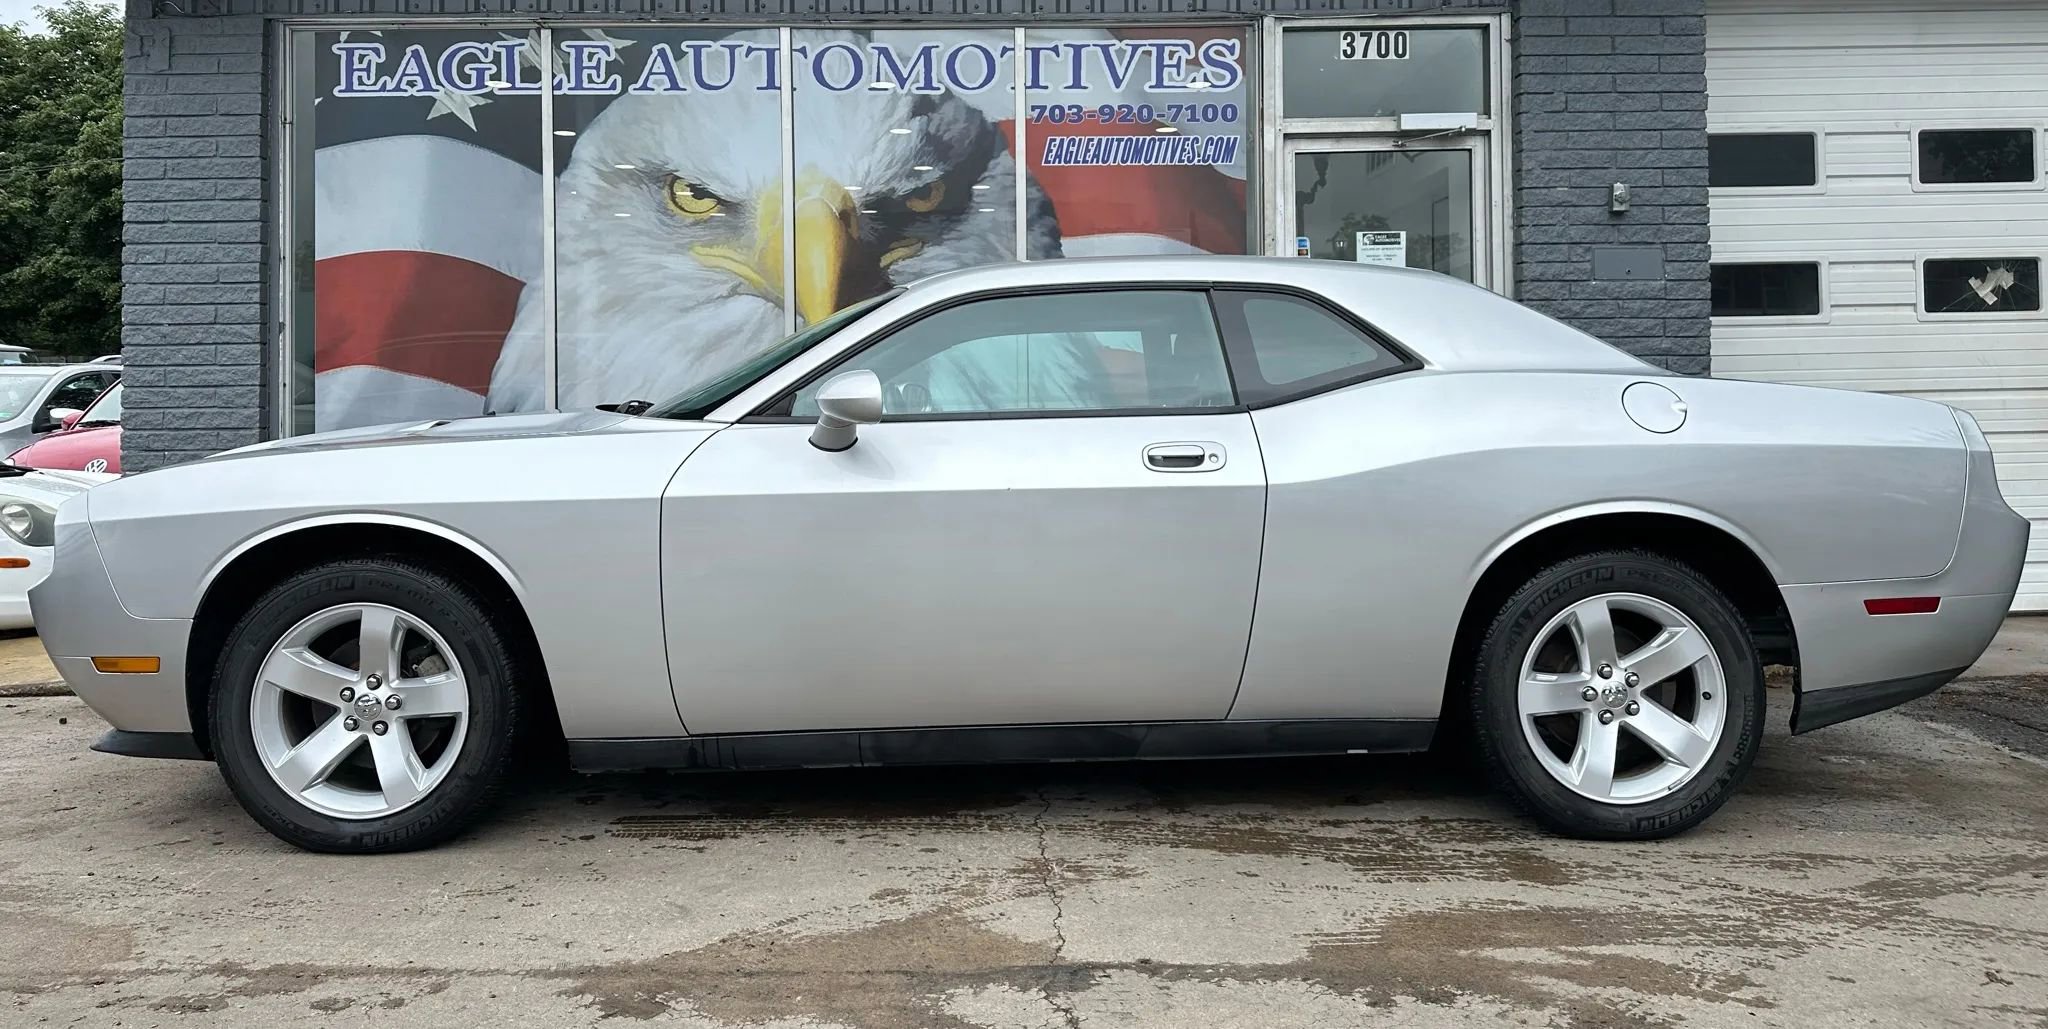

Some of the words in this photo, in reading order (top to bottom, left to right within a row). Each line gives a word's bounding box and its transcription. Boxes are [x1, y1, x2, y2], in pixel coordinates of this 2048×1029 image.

[1342, 31, 1408, 59] 3700
[334, 41, 620, 95] EAGLE
[630, 40, 1241, 94] AUTOMOTIVES
[1031, 103, 1239, 124] 703-920-7100
[1041, 135, 1240, 165] EAGLEAUTOMOTIVES.COM
[1528, 566, 1614, 616] MICHELIN
[1637, 781, 1723, 832] MICHELIN
